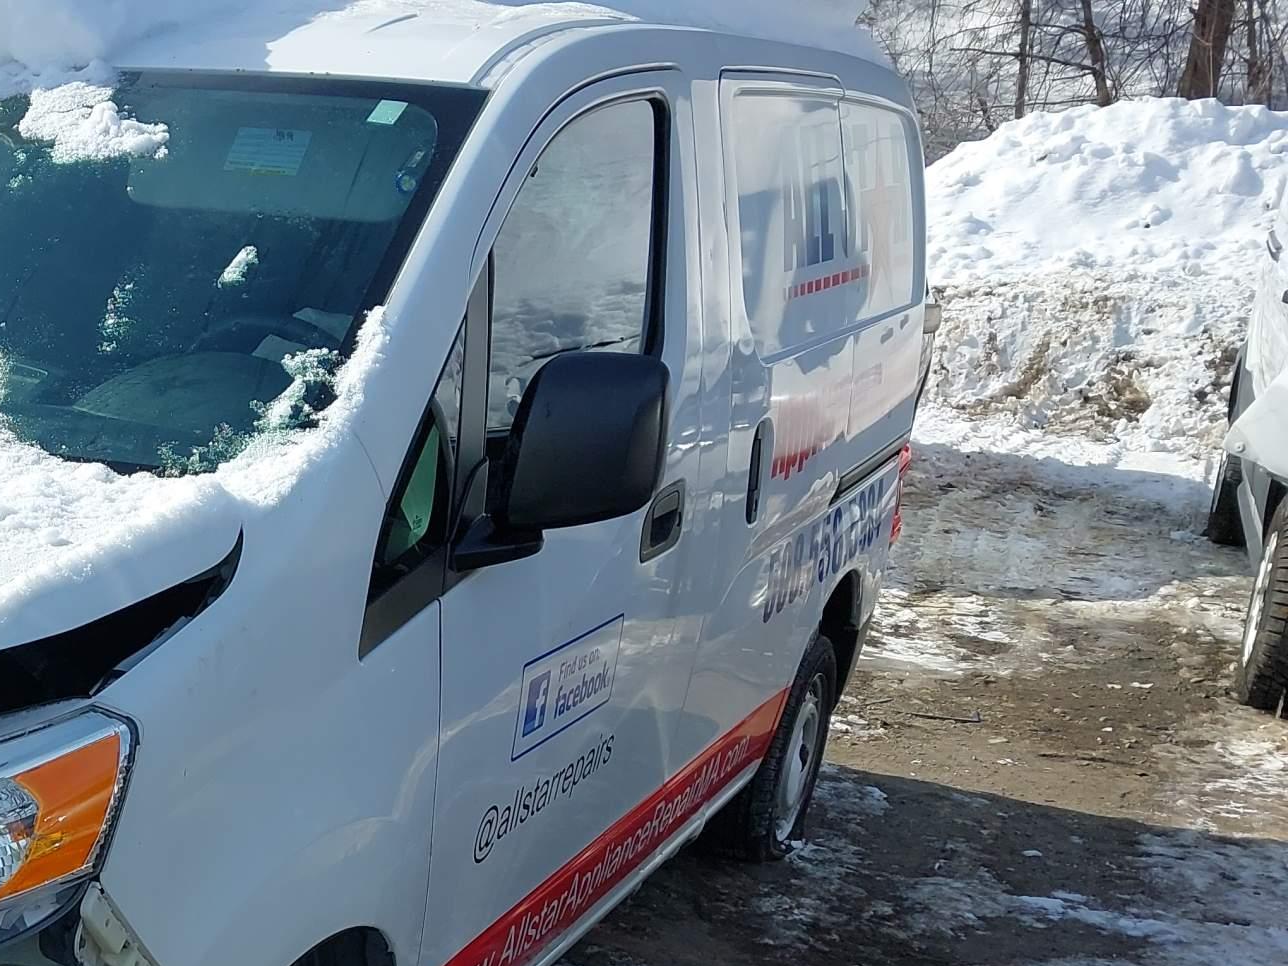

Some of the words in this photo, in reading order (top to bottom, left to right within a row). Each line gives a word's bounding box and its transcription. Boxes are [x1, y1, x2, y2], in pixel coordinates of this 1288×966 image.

[558, 656, 577, 682] Find
[578, 654, 588, 670] us
[473, 733, 615, 864] @allstarrepairs
